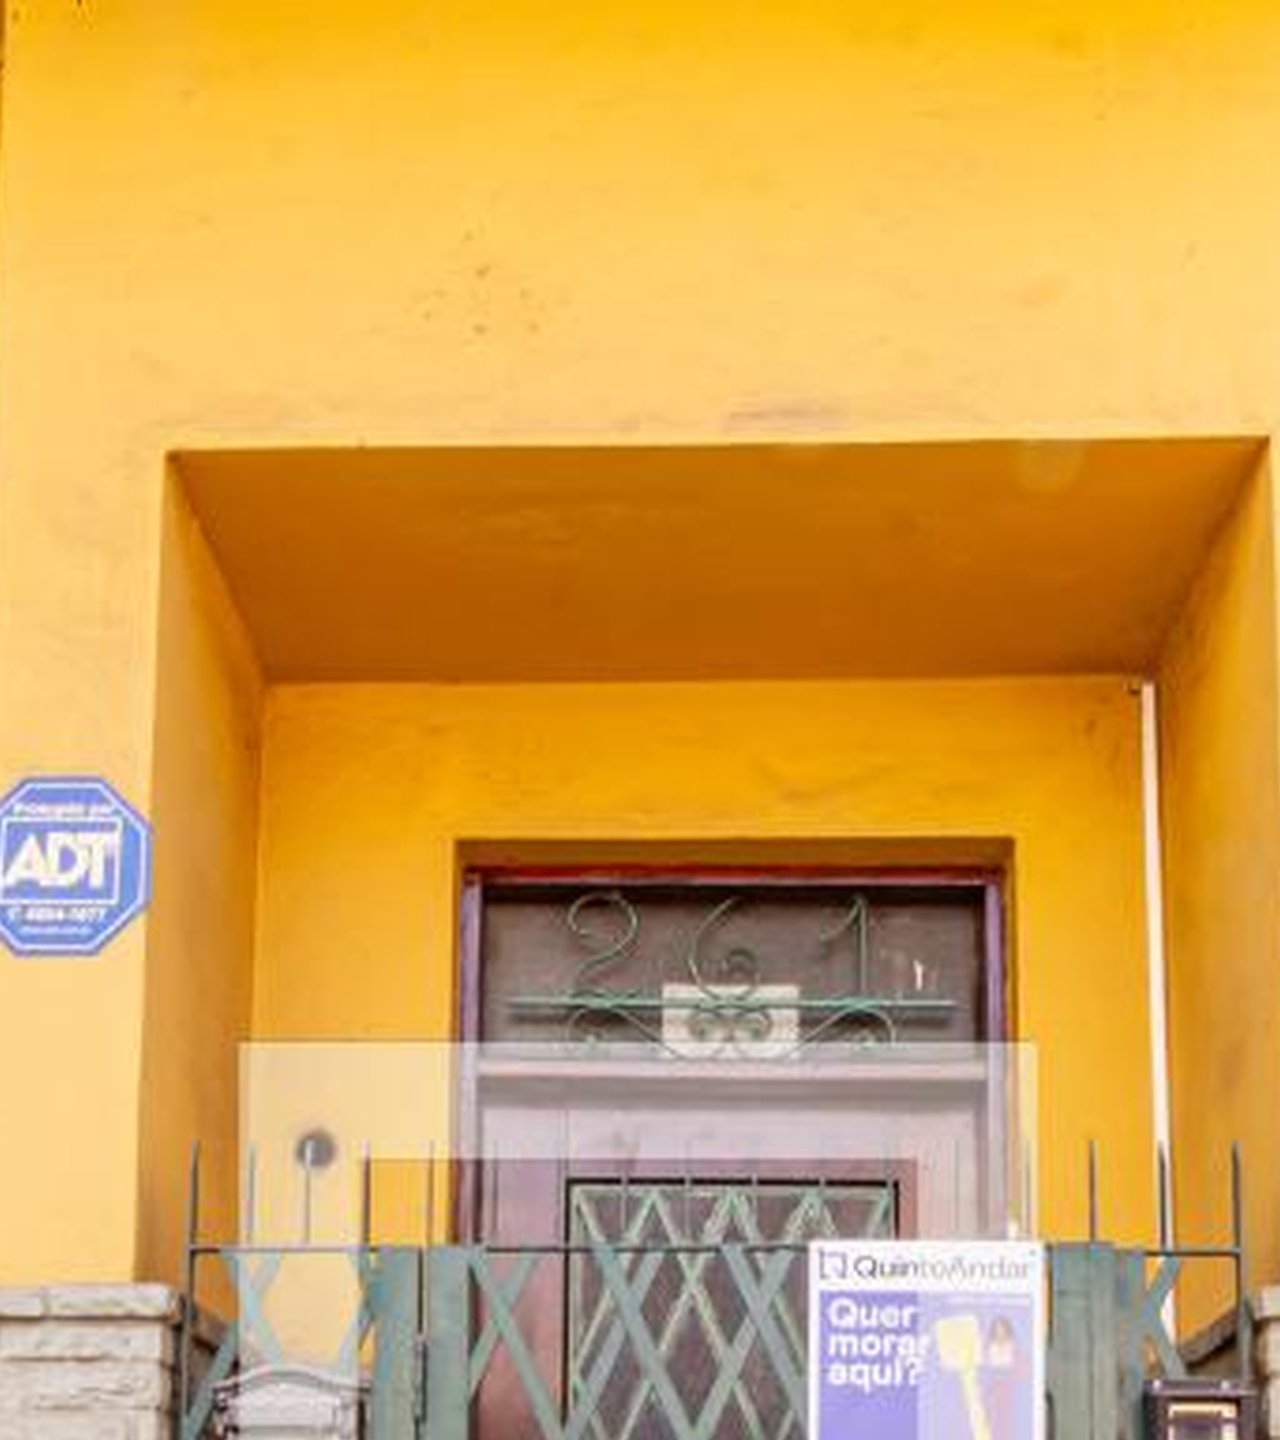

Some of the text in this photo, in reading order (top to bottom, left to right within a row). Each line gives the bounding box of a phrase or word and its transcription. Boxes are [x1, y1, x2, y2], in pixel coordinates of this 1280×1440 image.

[4, 831, 118, 889] ADT
[568, 892, 869, 1003] 261
[853, 1255, 1028, 1280] QuintoAndar
[827, 1299, 917, 1328] Quer
[827, 1331, 929, 1353] morar
[827, 1357, 921, 1392] aqui?
